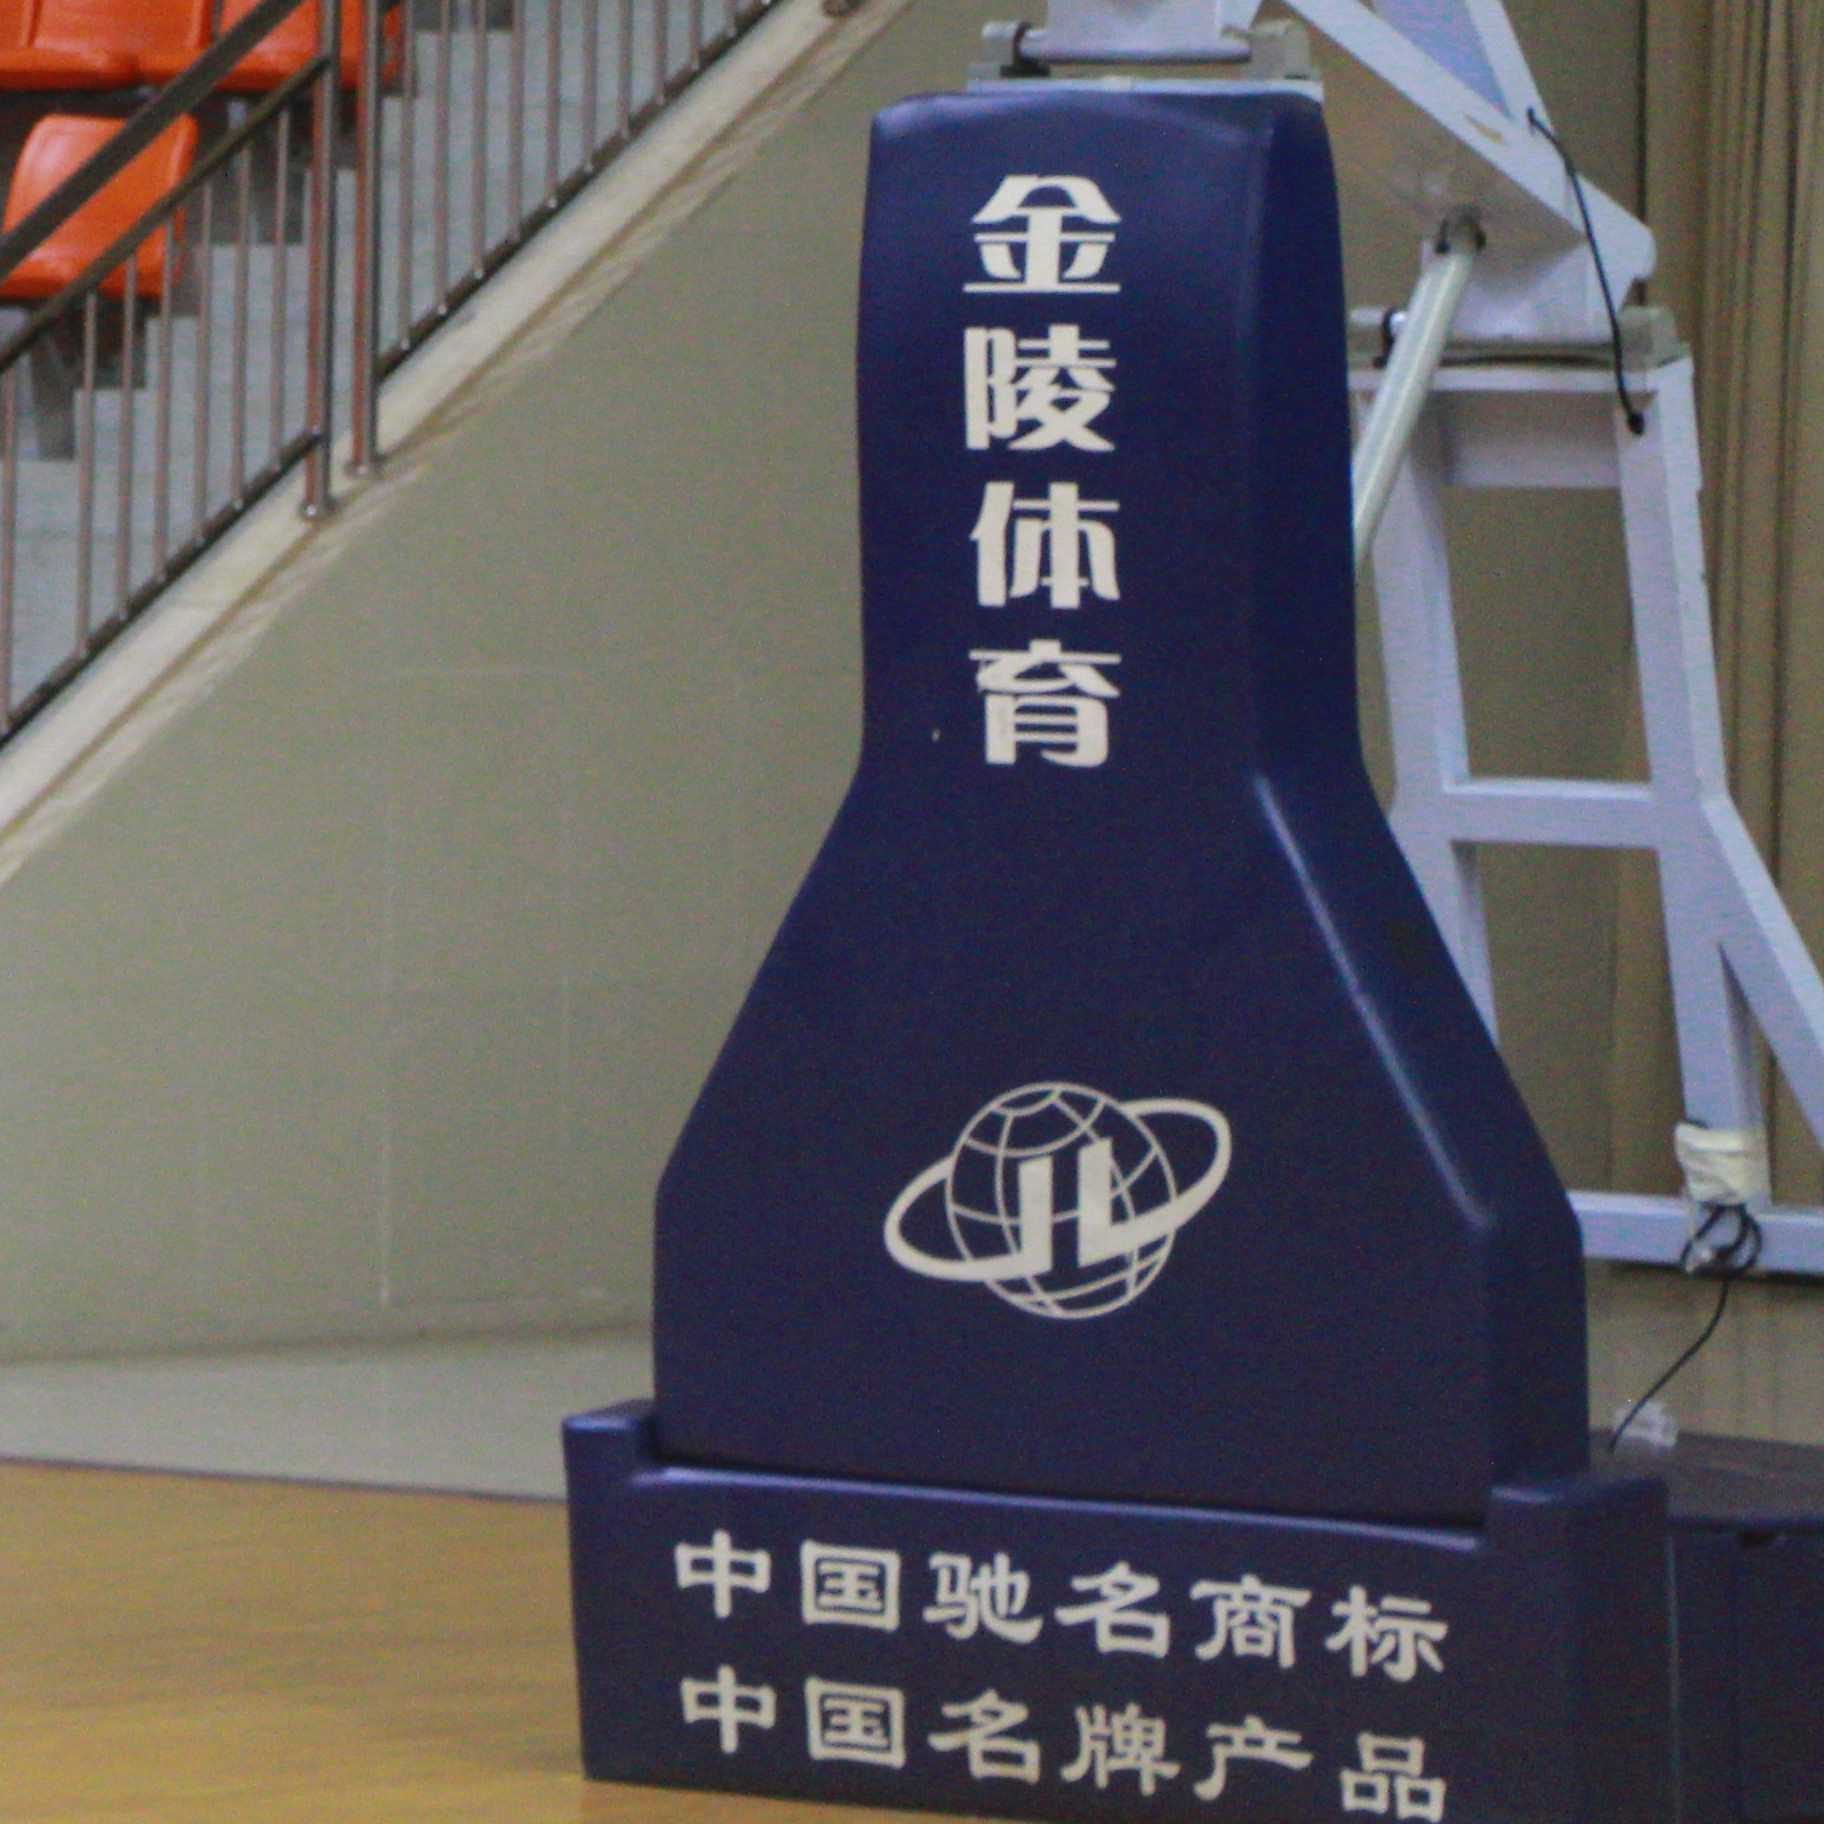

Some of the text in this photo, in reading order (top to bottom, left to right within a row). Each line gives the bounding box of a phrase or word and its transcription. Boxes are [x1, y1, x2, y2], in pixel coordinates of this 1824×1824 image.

[963, 175, 1121, 768] 金陵体育
[674, 1529, 1449, 1683] 中国驰名商标
[680, 1665, 1448, 1823] 中国名牌产品
